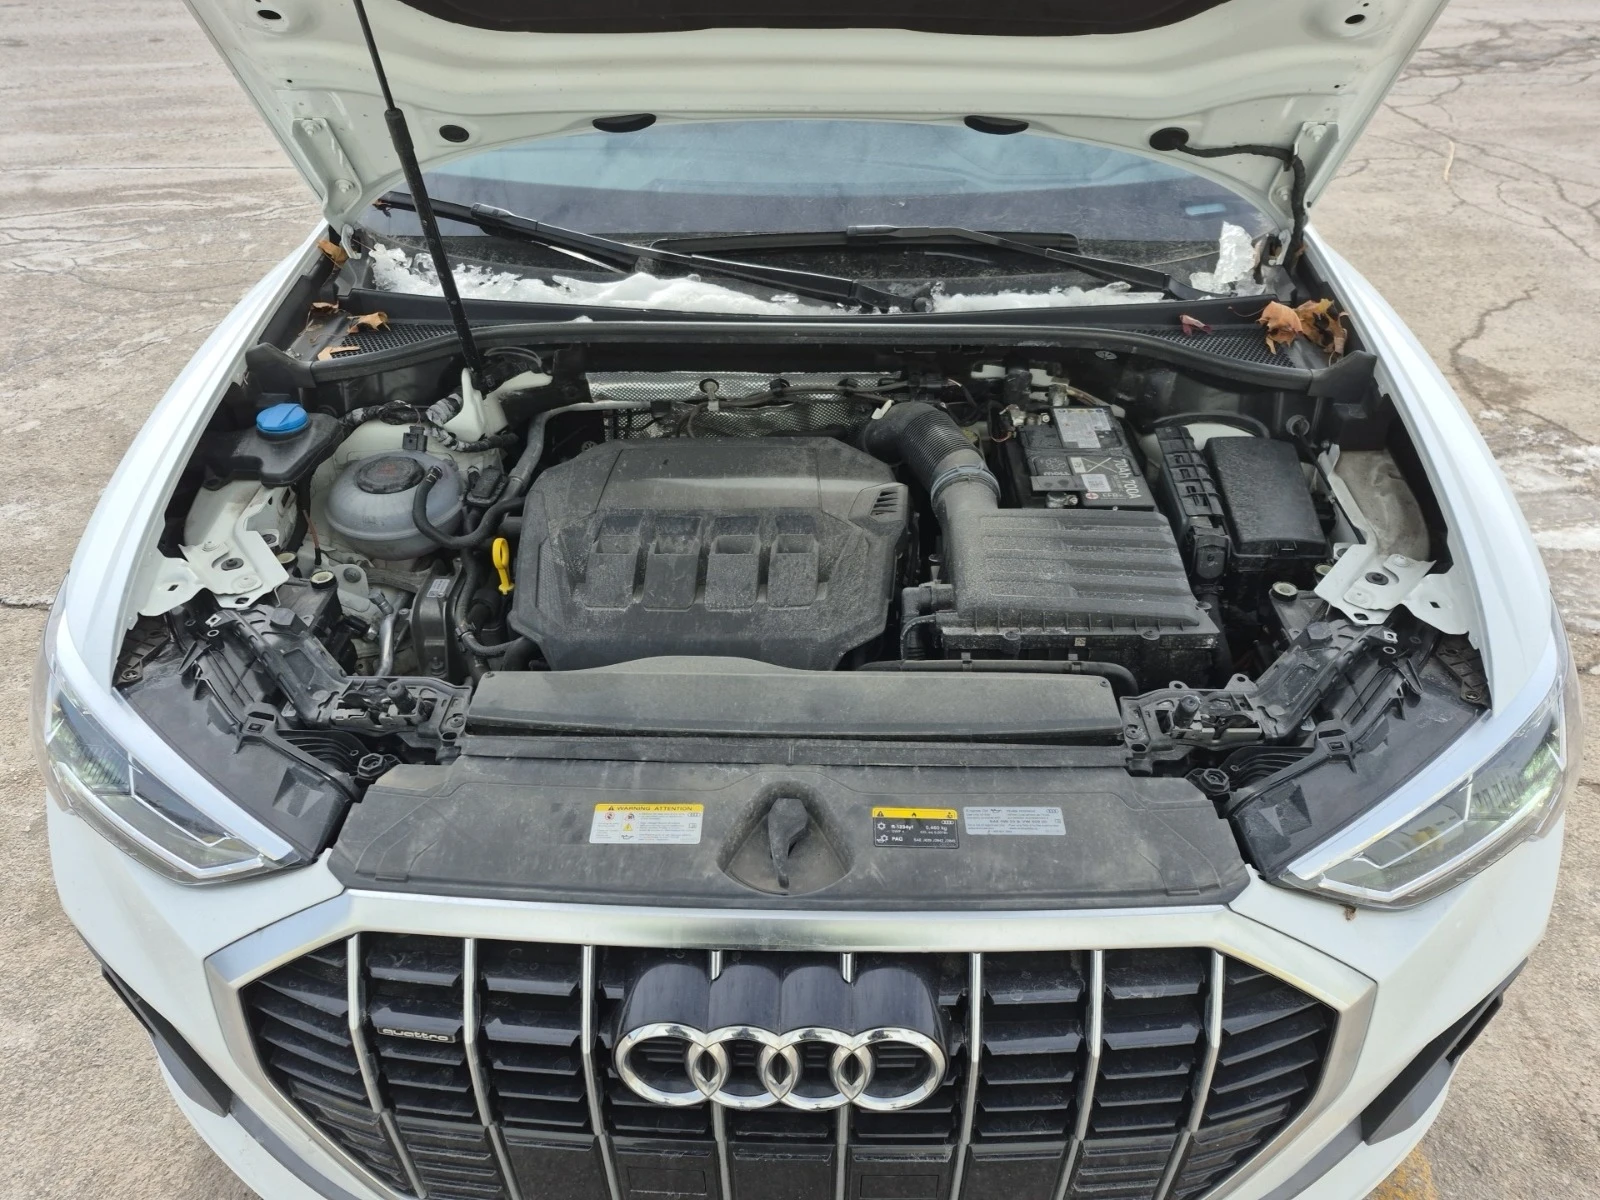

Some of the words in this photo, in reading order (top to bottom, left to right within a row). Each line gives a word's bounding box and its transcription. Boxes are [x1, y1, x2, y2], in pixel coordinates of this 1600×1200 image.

[1113, 458, 1131, 478] 70Ah
[1122, 479, 1142, 499] 700A
[382, 1028, 449, 1041] quattro
